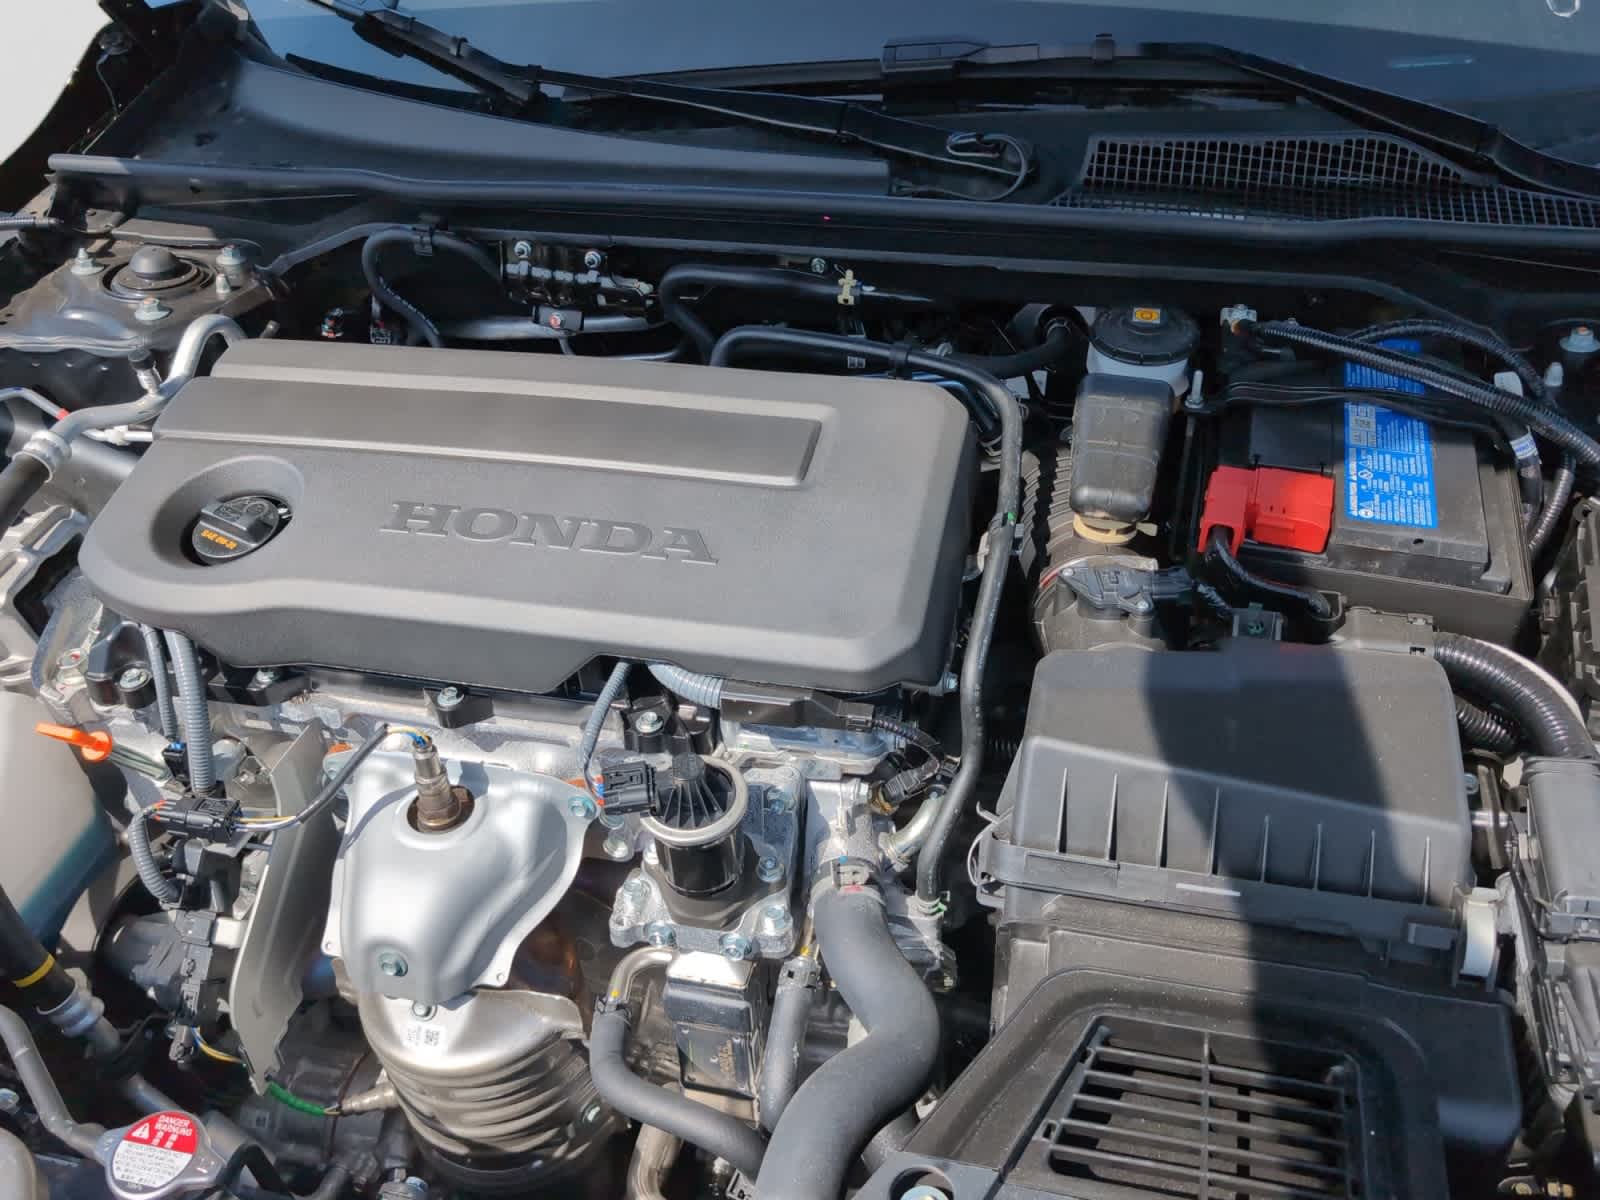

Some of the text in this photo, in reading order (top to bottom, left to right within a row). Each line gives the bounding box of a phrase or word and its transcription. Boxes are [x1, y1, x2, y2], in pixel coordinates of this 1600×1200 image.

[380, 501, 719, 566] HONDA
[155, 1121, 193, 1136] WARNING
[159, 1115, 190, 1128] DANGER
